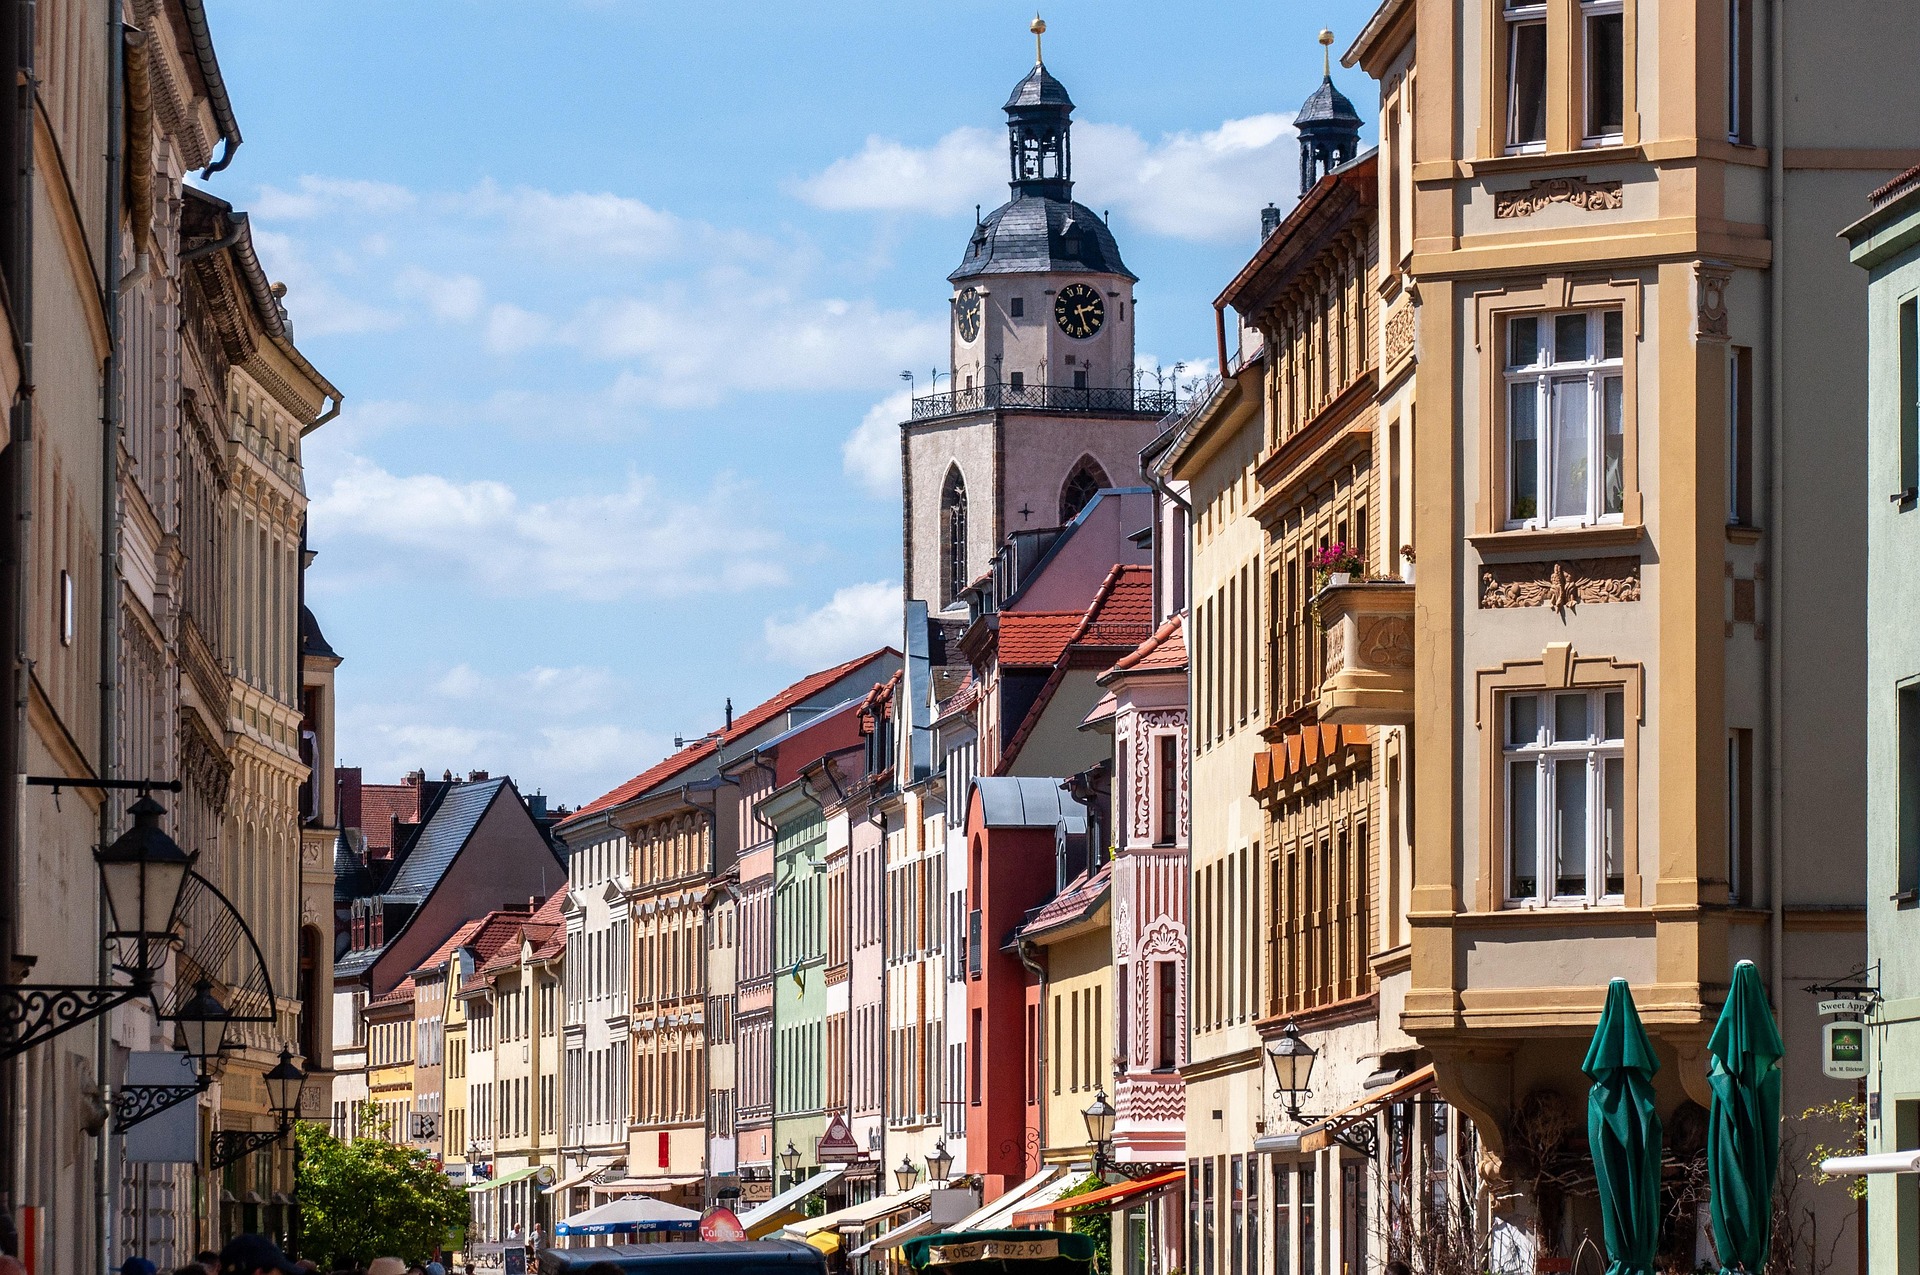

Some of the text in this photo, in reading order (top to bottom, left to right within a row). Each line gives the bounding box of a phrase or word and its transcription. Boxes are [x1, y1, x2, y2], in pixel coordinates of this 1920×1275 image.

[1821, 1001, 1845, 1011] Sweet
[1003, 1244, 1023, 1256] 872
[1028, 1244, 1042, 1254] 90
